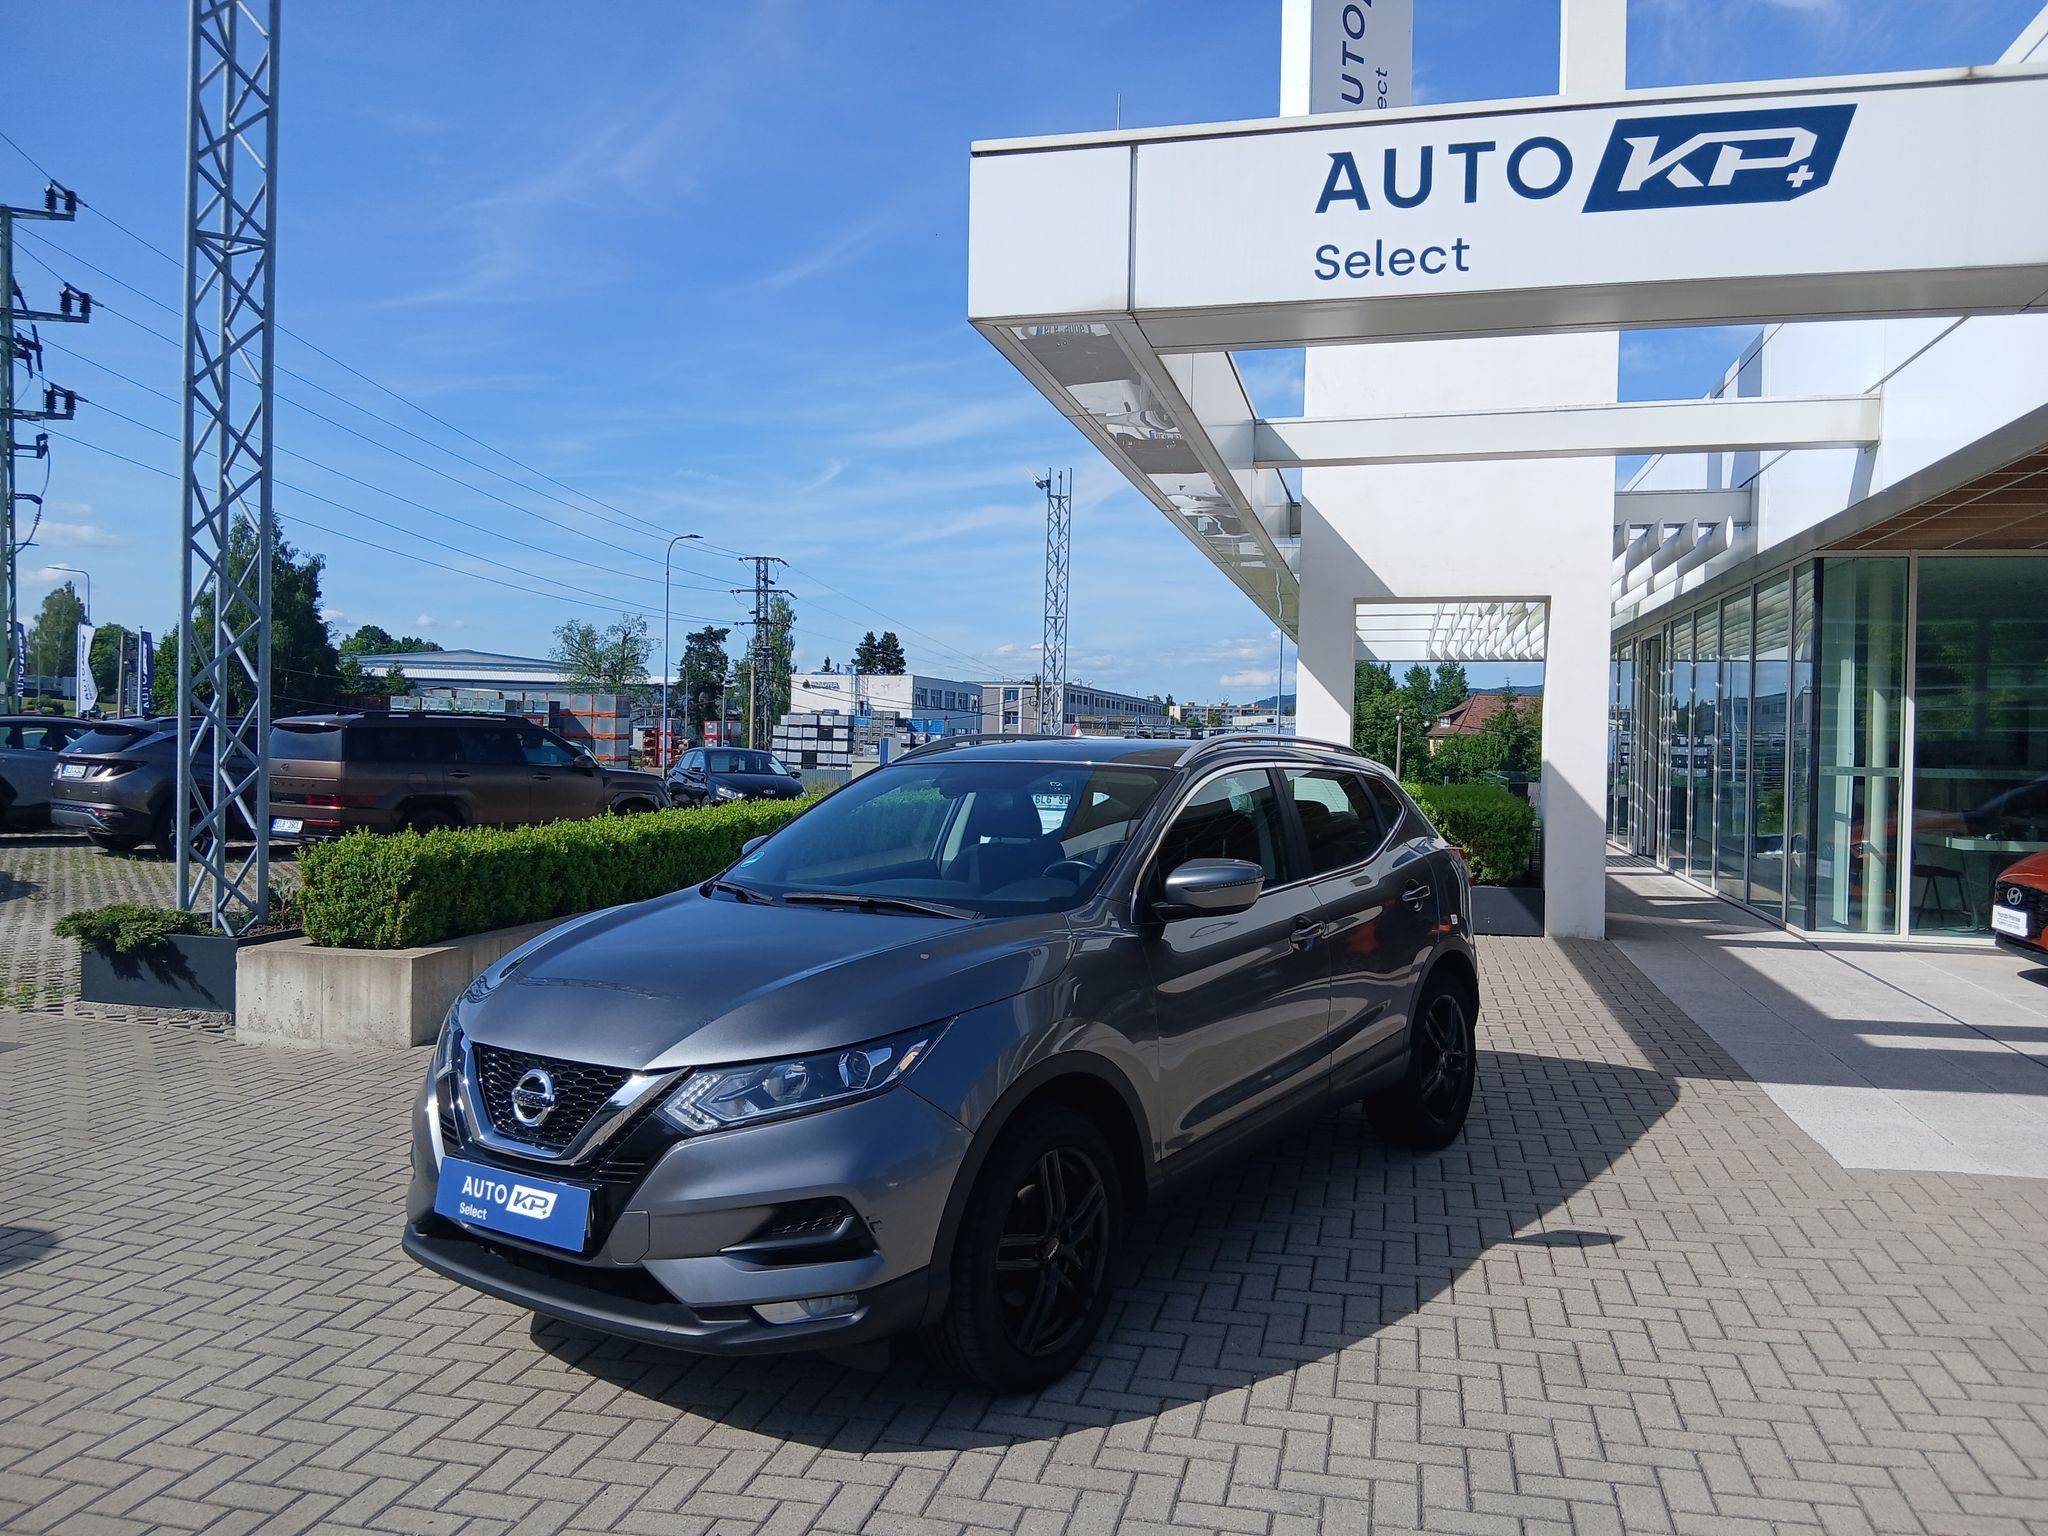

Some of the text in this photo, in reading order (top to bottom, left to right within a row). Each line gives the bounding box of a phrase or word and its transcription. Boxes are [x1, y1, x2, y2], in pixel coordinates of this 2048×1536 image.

[1341, 4, 1365, 104] UTO
[1375, 67, 1388, 109] ect
[1314, 135, 1573, 214] AUTO
[1313, 238, 1470, 281] Select
[1035, 794, 1070, 805] 6L6 90
[459, 1201, 488, 1220] Select
[461, 1175, 508, 1204] AUTO
